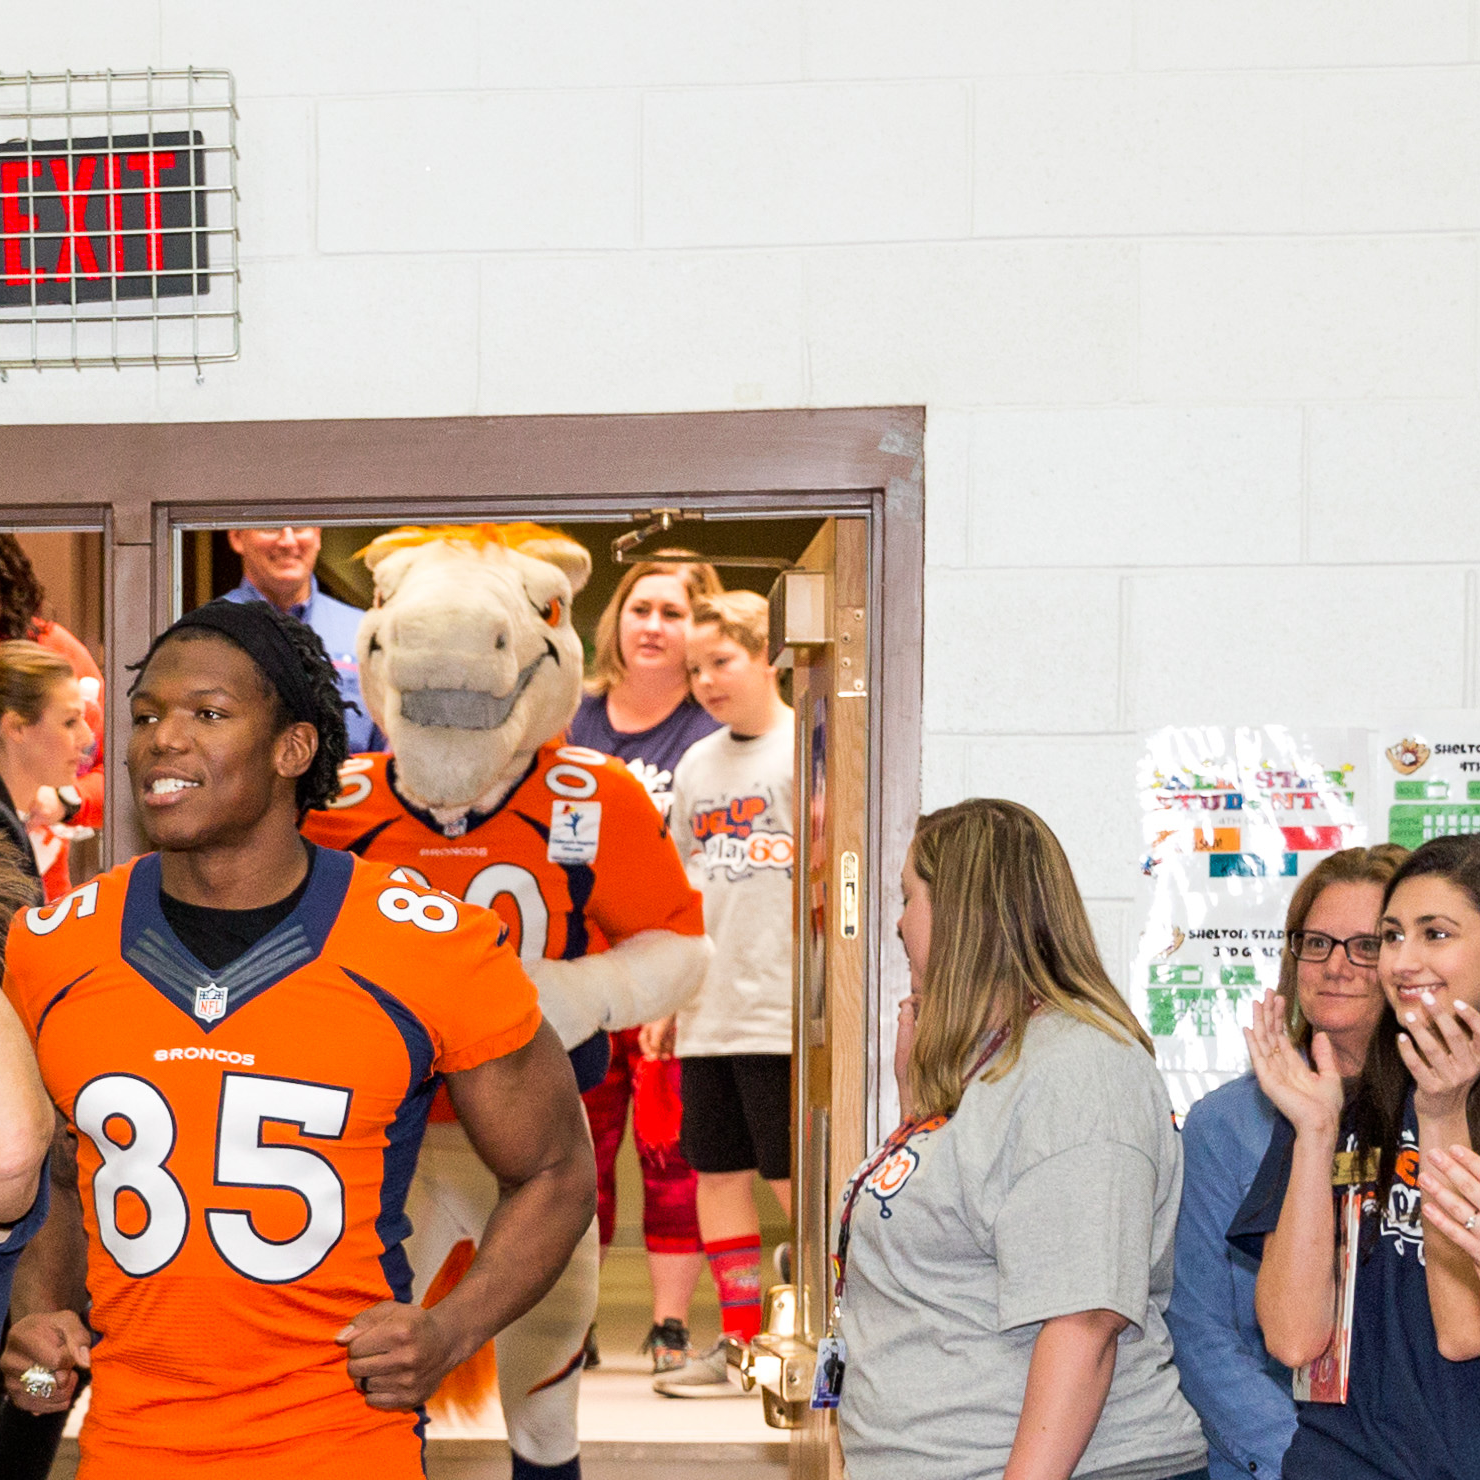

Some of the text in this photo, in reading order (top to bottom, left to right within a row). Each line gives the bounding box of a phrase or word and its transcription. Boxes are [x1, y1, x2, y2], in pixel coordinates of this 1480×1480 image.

[1, 152, 175, 286] EXIT
[730, 796, 767, 823] UP
[200, 1000, 222, 1015] NFL
[153, 1046, 256, 1067] BRONCOS
[75, 1071, 353, 1285] 85
